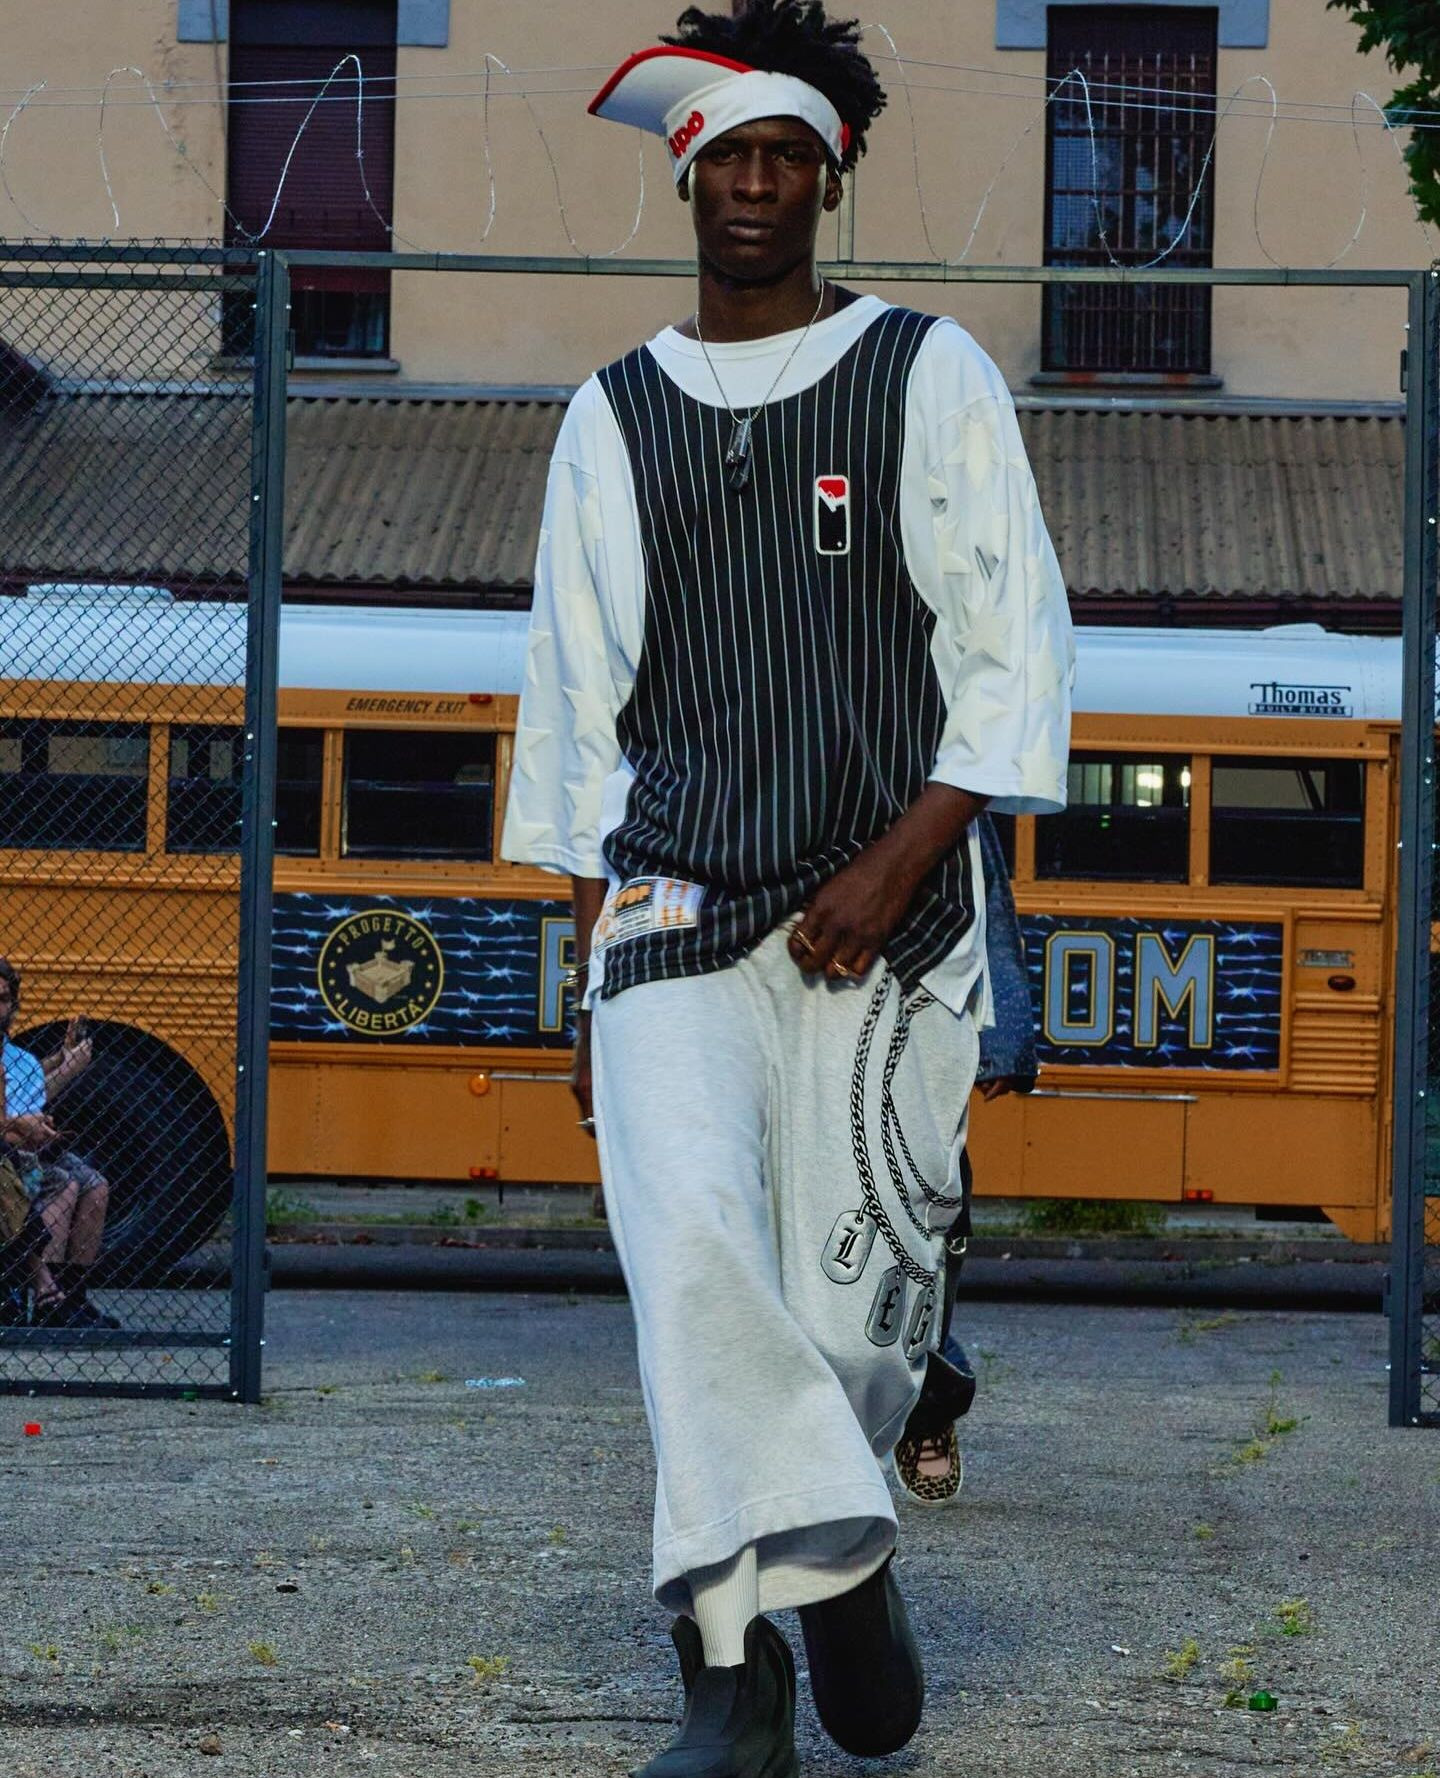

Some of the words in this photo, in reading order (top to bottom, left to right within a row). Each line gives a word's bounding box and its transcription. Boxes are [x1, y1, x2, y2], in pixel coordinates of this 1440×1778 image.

[1250, 682, 1351, 704] Thomas
[346, 697, 434, 714] EMERGENCY
[435, 701, 467, 714] EXIT
[338, 917, 425, 948] PROGETTO
